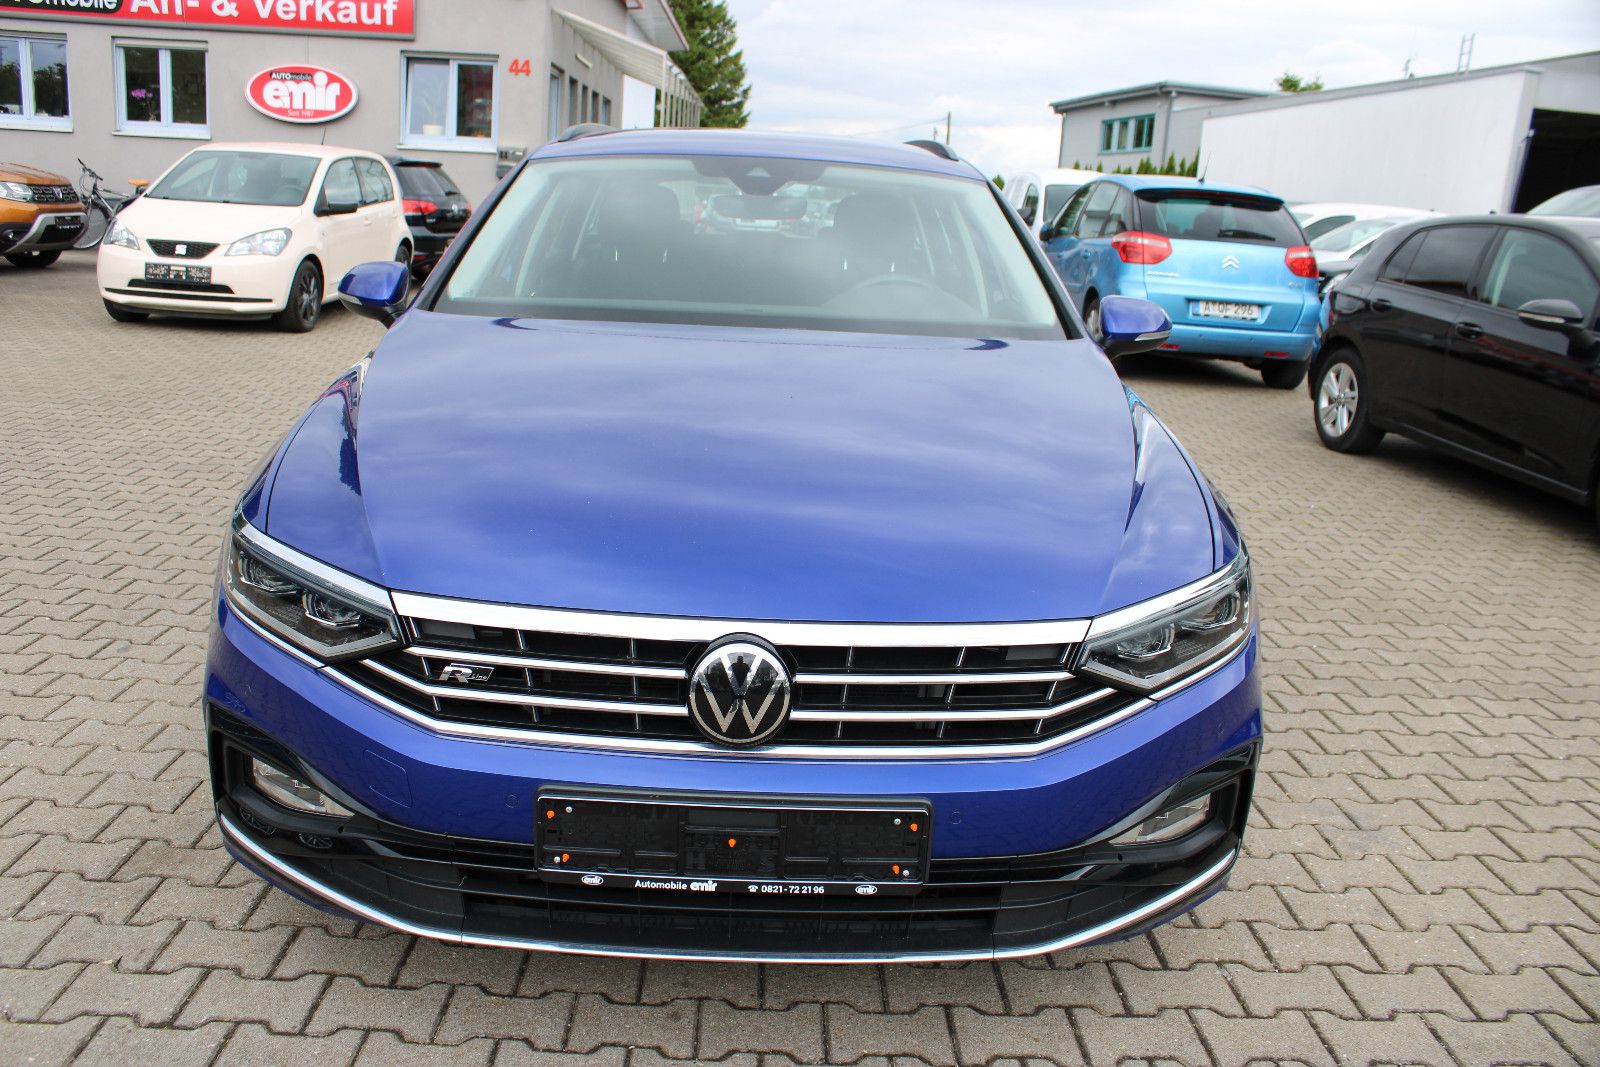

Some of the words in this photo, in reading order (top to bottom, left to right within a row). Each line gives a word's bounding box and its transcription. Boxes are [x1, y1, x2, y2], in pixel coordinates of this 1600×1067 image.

[211, 0, 239, 17] &
[254, 0, 398, 25] Verkauf
[509, 59, 531, 76] 44
[263, 71, 340, 111] emir
[634, 879, 687, 890] Automobile
[690, 880, 718, 891] emir
